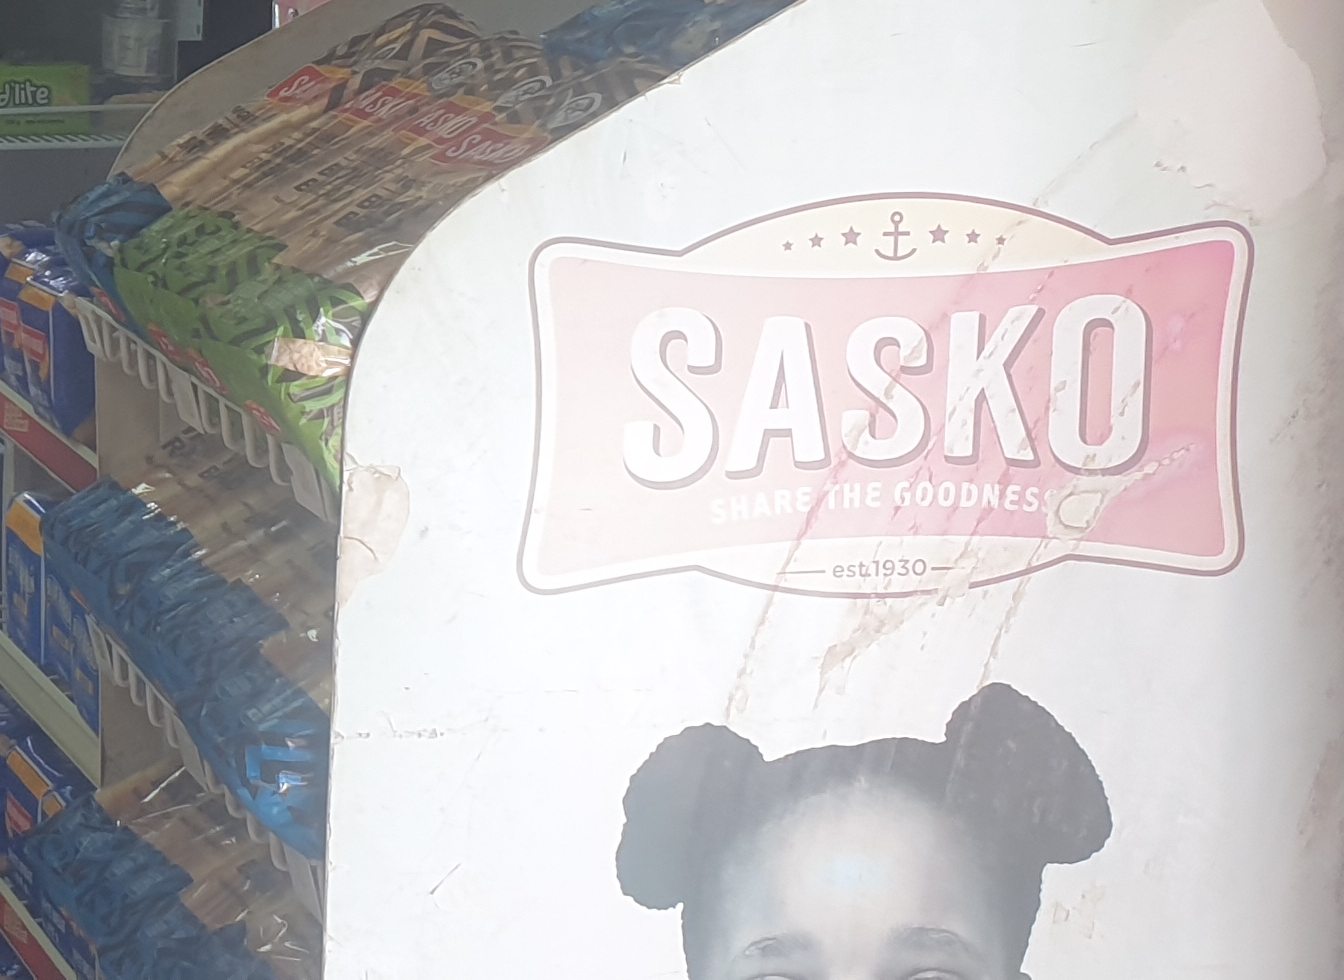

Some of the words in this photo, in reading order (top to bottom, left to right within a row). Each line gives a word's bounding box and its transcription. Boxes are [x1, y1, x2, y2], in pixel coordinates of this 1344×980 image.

[622, 293, 1153, 490] SASKO
[712, 486, 813, 524] SHARE
[824, 481, 883, 510] THE
